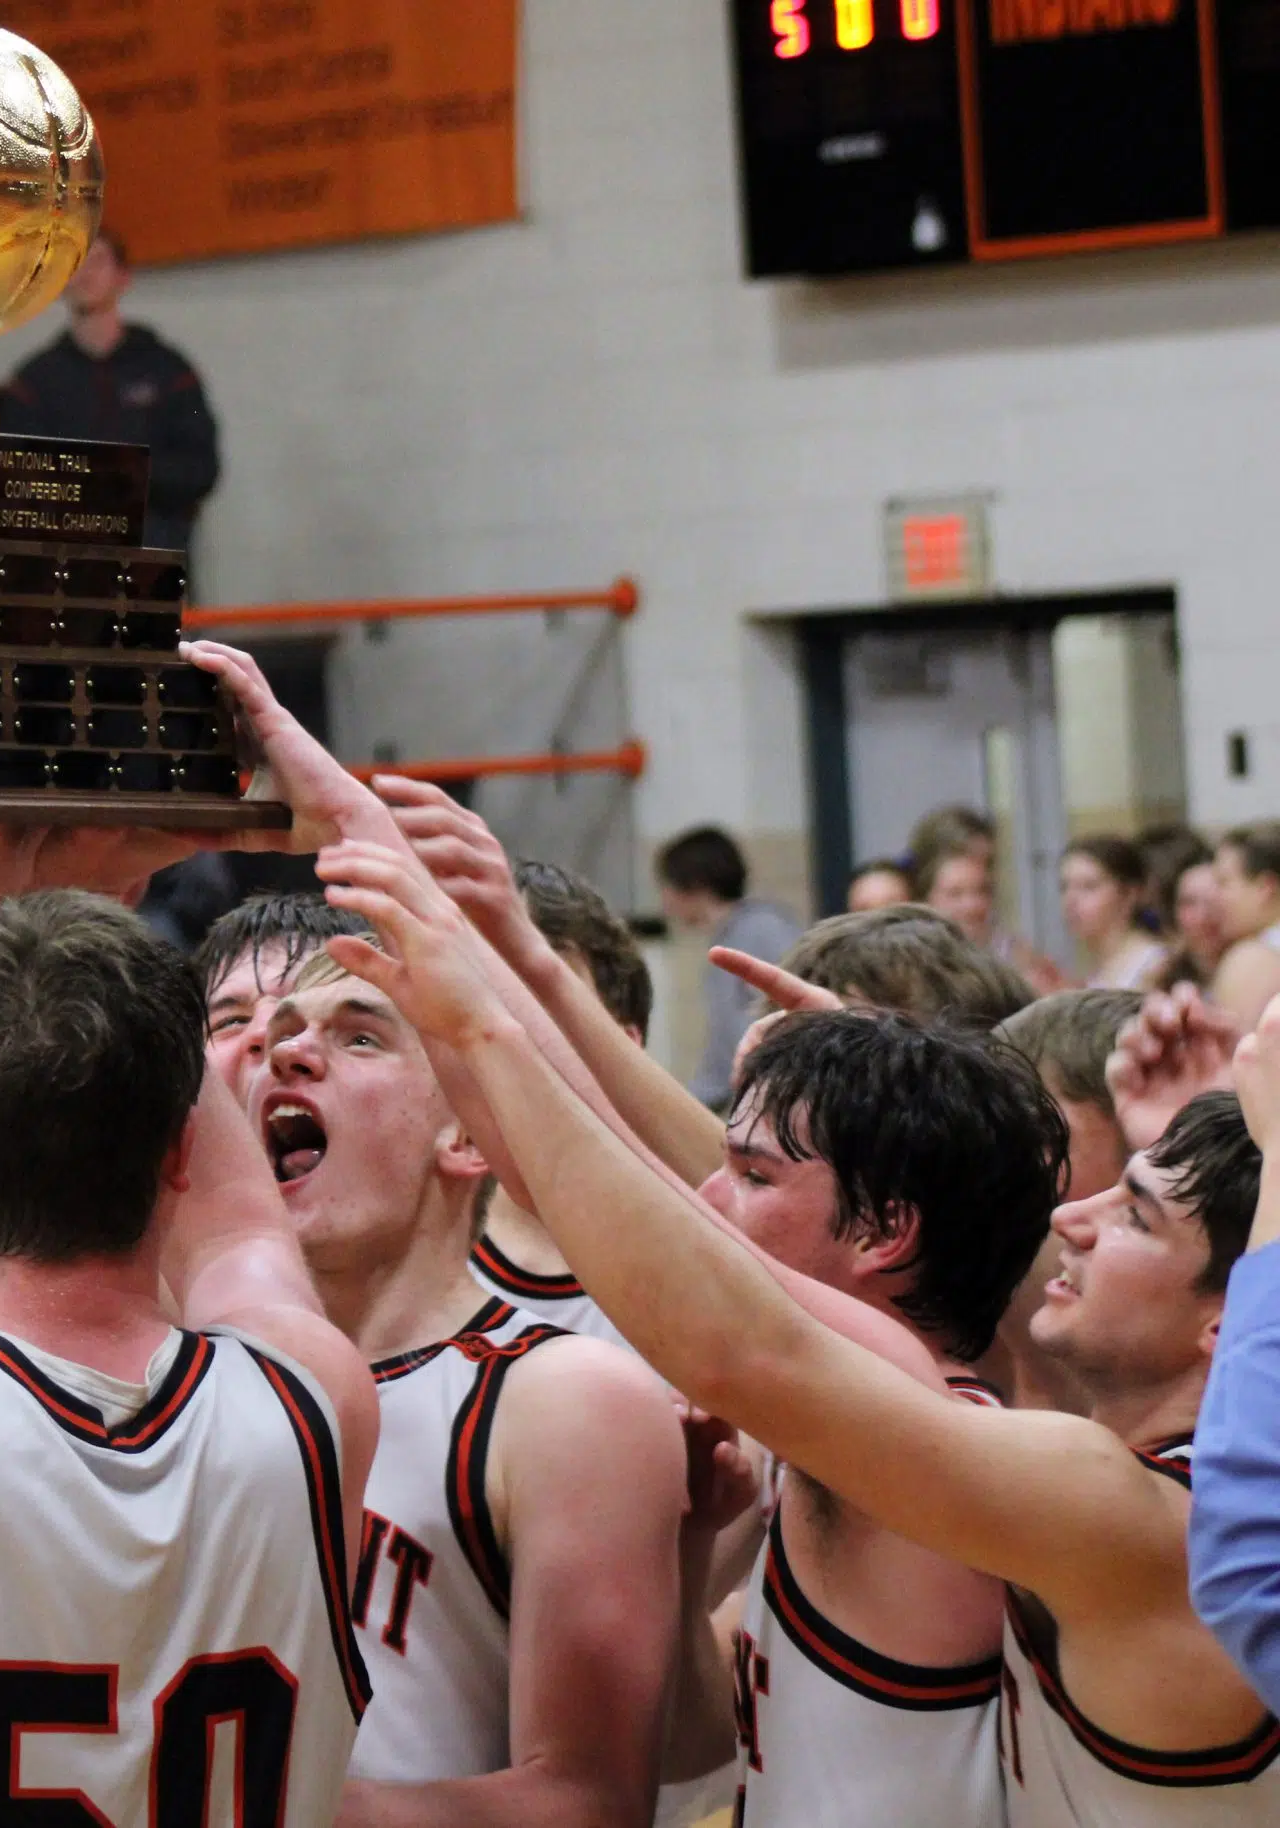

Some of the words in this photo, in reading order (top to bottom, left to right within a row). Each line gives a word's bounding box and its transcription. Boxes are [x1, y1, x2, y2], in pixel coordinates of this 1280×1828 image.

[59, 454, 91, 473] TRAIL
[4, 480, 82, 502] CONFERENCE
[62, 512, 129, 534] CHAMPIONS
